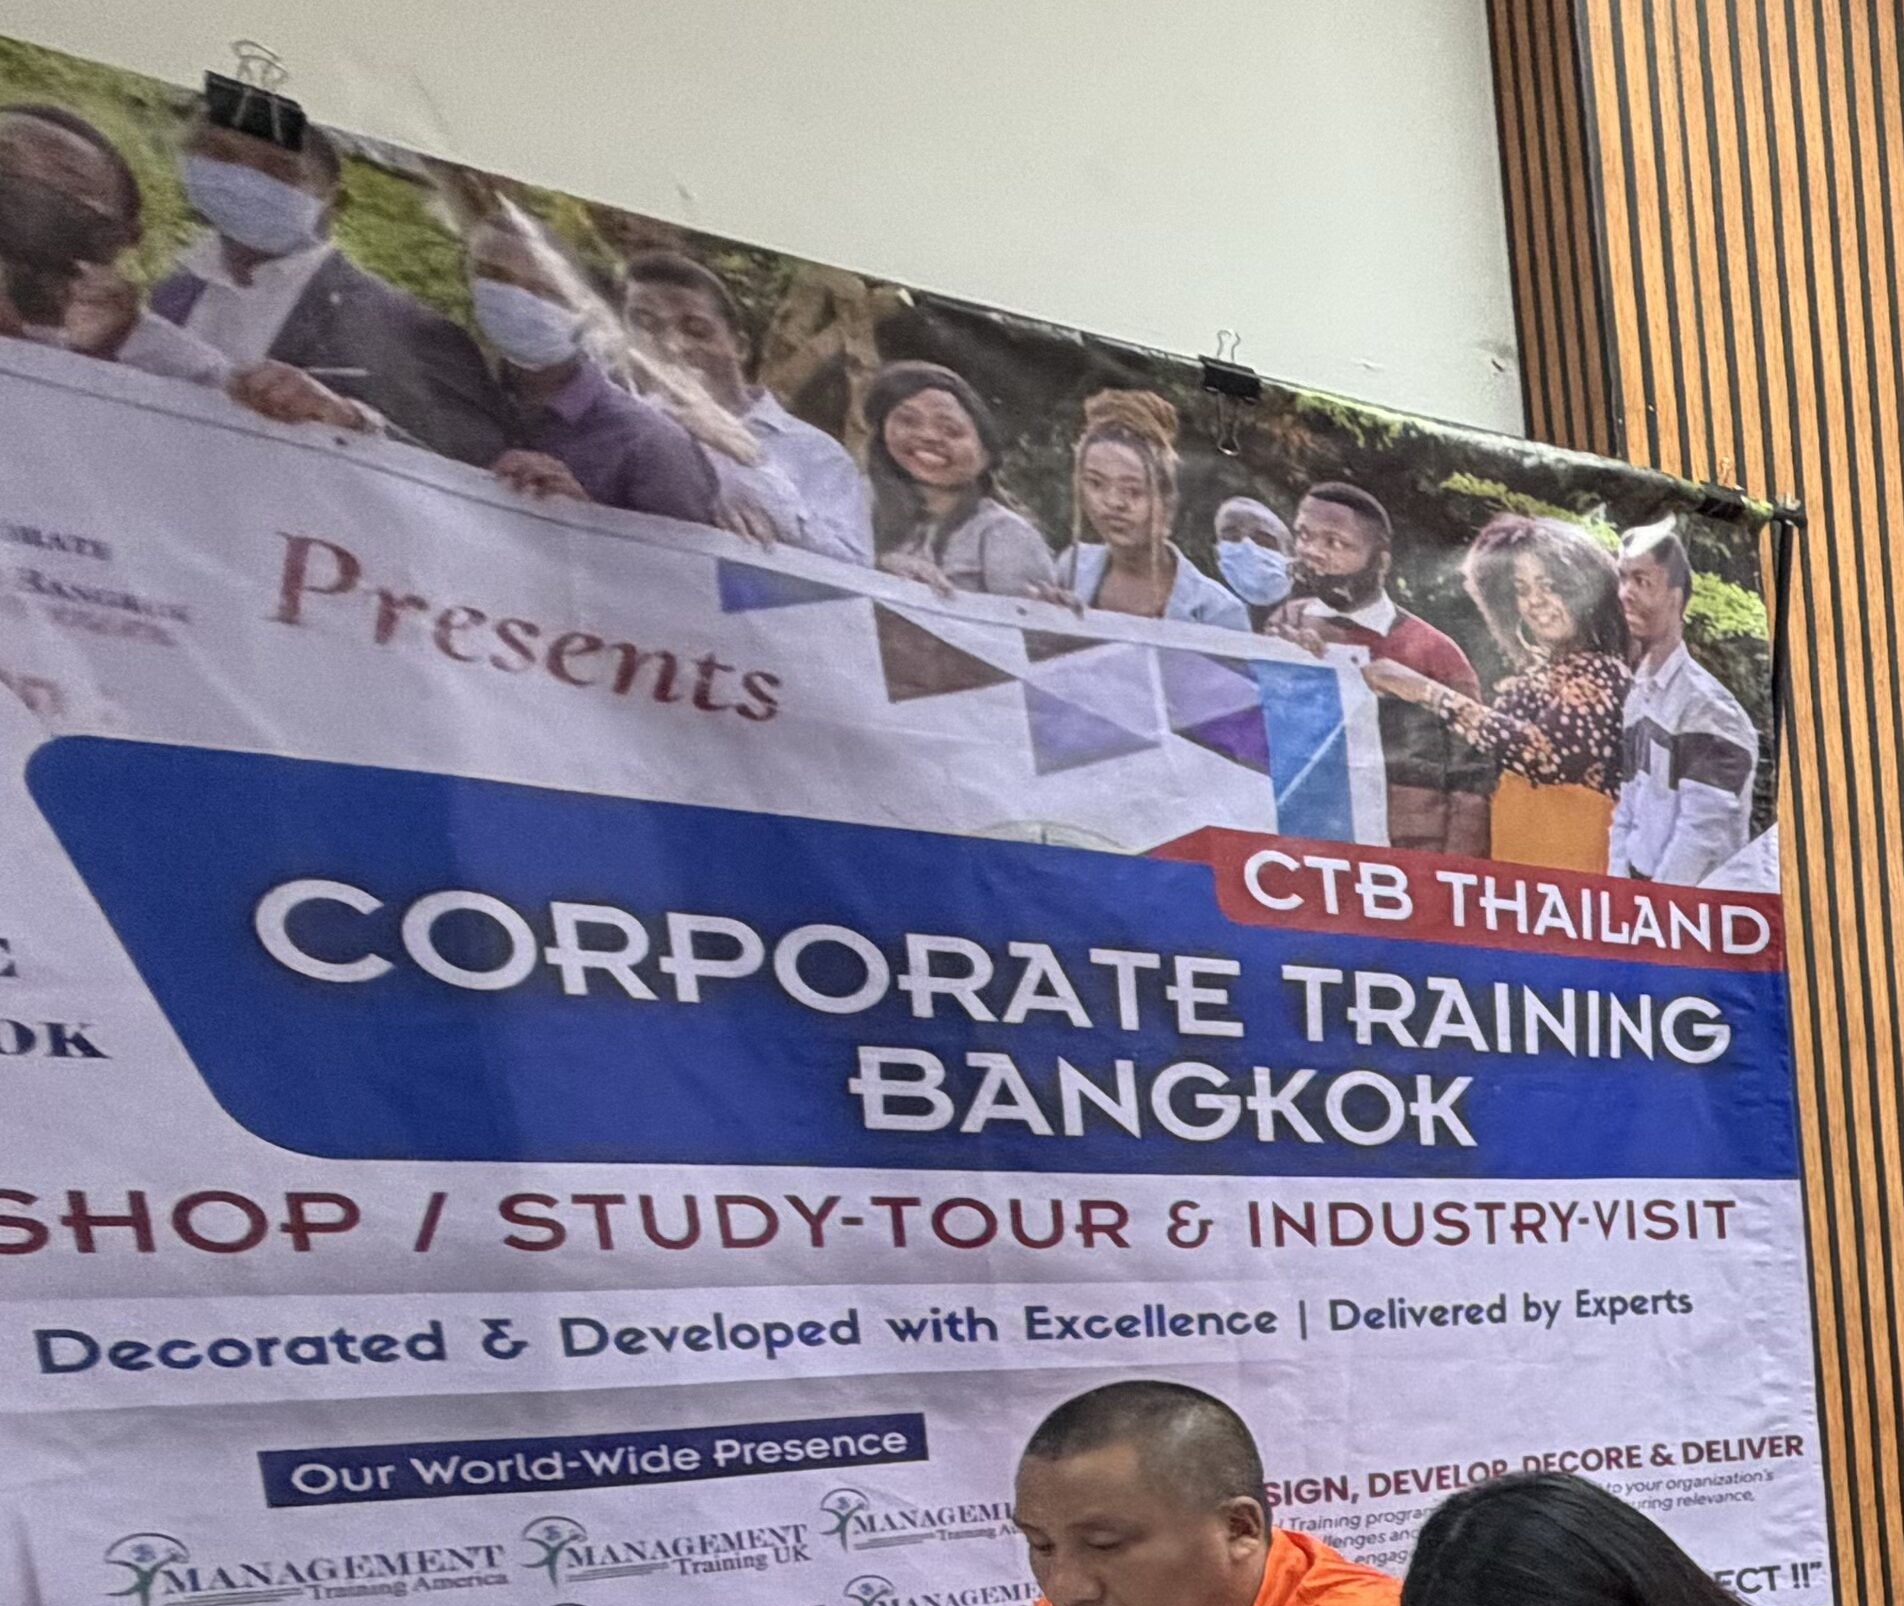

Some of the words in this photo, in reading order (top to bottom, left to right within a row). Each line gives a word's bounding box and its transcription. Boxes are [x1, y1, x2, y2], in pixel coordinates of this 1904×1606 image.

[265, 530, 784, 722] Presents
[1243, 847, 1414, 922] CTB
[1436, 870, 1772, 957] THAILAND
[254, 877, 1246, 1039] CORPORATE
[1283, 963, 1731, 1066] TRAINING
[848, 1045, 1479, 1148] BANGKOK
[503, 1192, 1131, 1253] STUDY-TOUR
[1249, 1197, 1737, 1250] INDUSTRY-VISIT
[34, 1320, 447, 1377] Decorated
[561, 1306, 862, 1361] Developed
[885, 1305, 999, 1347] with
[1025, 1301, 1279, 1344] Excellence
[1329, 1296, 1508, 1333] Delivered
[1522, 1289, 1563, 1330] by
[1575, 1286, 1694, 1324] Experts
[289, 1459, 396, 1497] Our
[410, 1443, 702, 1488] World-Wide
[713, 1430, 909, 1468] Presence
[1682, 1435, 1804, 1464] DELIVER
[1288, 1511, 1360, 1531] Training
[1625, 1478, 1663, 1497] your
[1667, 1468, 1776, 1491] organization's
[163, 1545, 505, 1595] MANAGEMENT
[568, 1524, 808, 1569] MANAGEMENT
[673, 1552, 768, 1577] Training
[773, 1543, 812, 1565] UK
